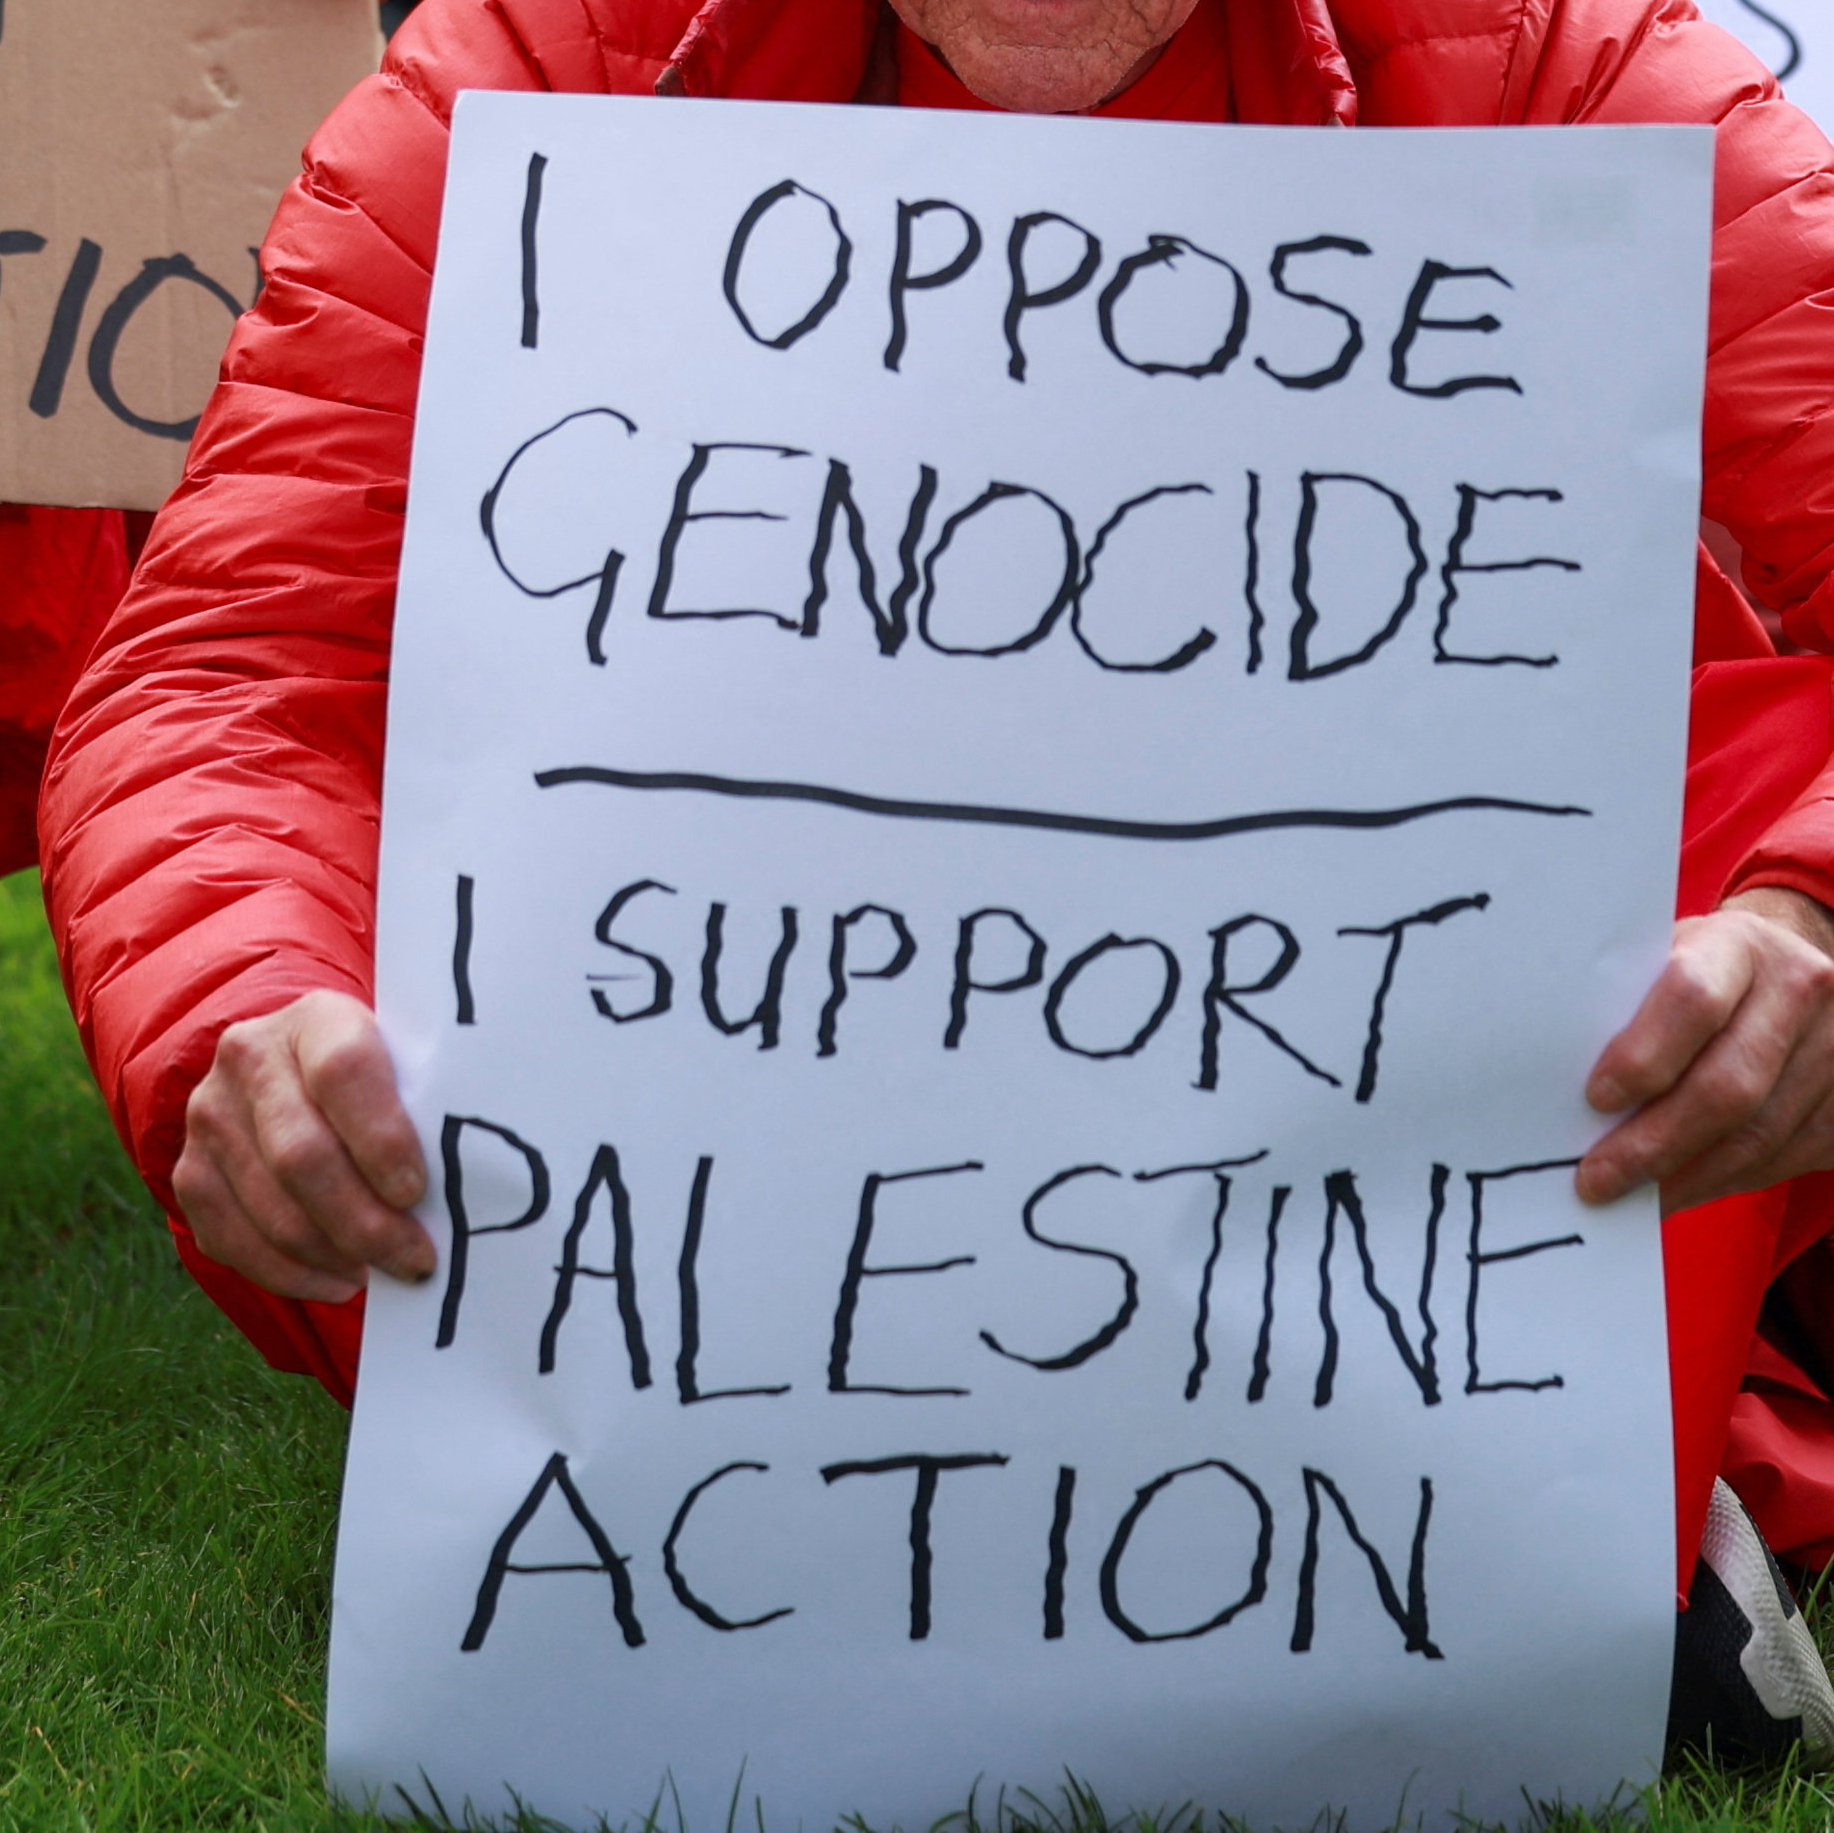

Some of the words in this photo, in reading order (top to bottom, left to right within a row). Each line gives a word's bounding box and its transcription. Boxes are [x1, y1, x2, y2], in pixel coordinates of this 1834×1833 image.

[520, 151, 549, 350] I
[722, 176, 1525, 397] OPPOSE
[479, 406, 1583, 683] GENOCIDE
[452, 874, 478, 1026] I
[585, 878, 1493, 1103] SUPPORT
[434, 1111, 1585, 1408] PALESTINE
[460, 1450, 1446, 1660] ACTION
